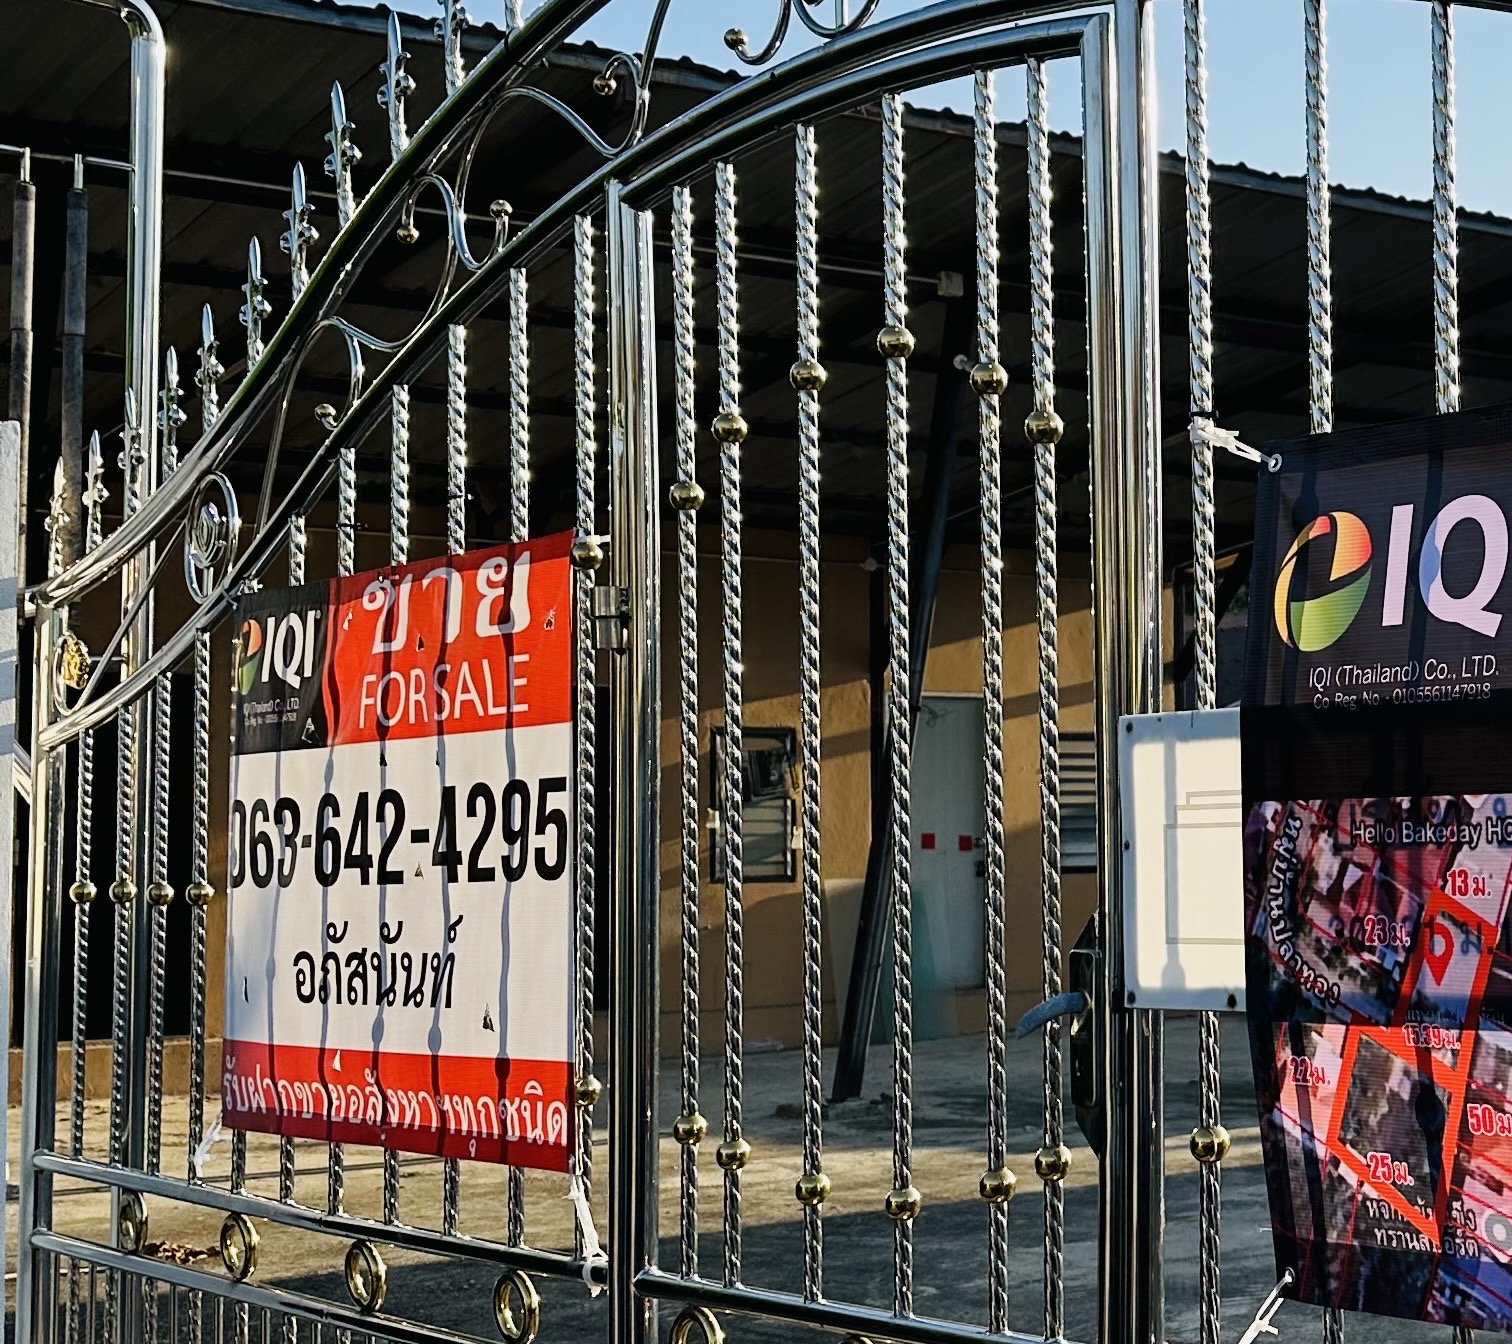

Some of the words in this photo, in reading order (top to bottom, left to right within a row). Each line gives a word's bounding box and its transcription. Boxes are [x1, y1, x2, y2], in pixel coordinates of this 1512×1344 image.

[362, 551, 531, 655] ขาย
[261, 610, 316, 690] IQI
[1309, 667, 1332, 691] IQI
[1336, 661, 1419, 687] (Thailand)
[1461, 655, 1499, 678] LTD.
[358, 668, 426, 729] FOR
[432, 654, 529, 721] SALE
[230, 777, 567, 889] 063-642-4295
[1448, 869, 1470, 897] 13
[1363, 915, 1389, 946] 23
[292, 914, 464, 1009] อภัสนันท์
[1289, 1056, 1312, 1086] 22
[1467, 1104, 1496, 1136] 50
[1367, 1152, 1392, 1183] 25
